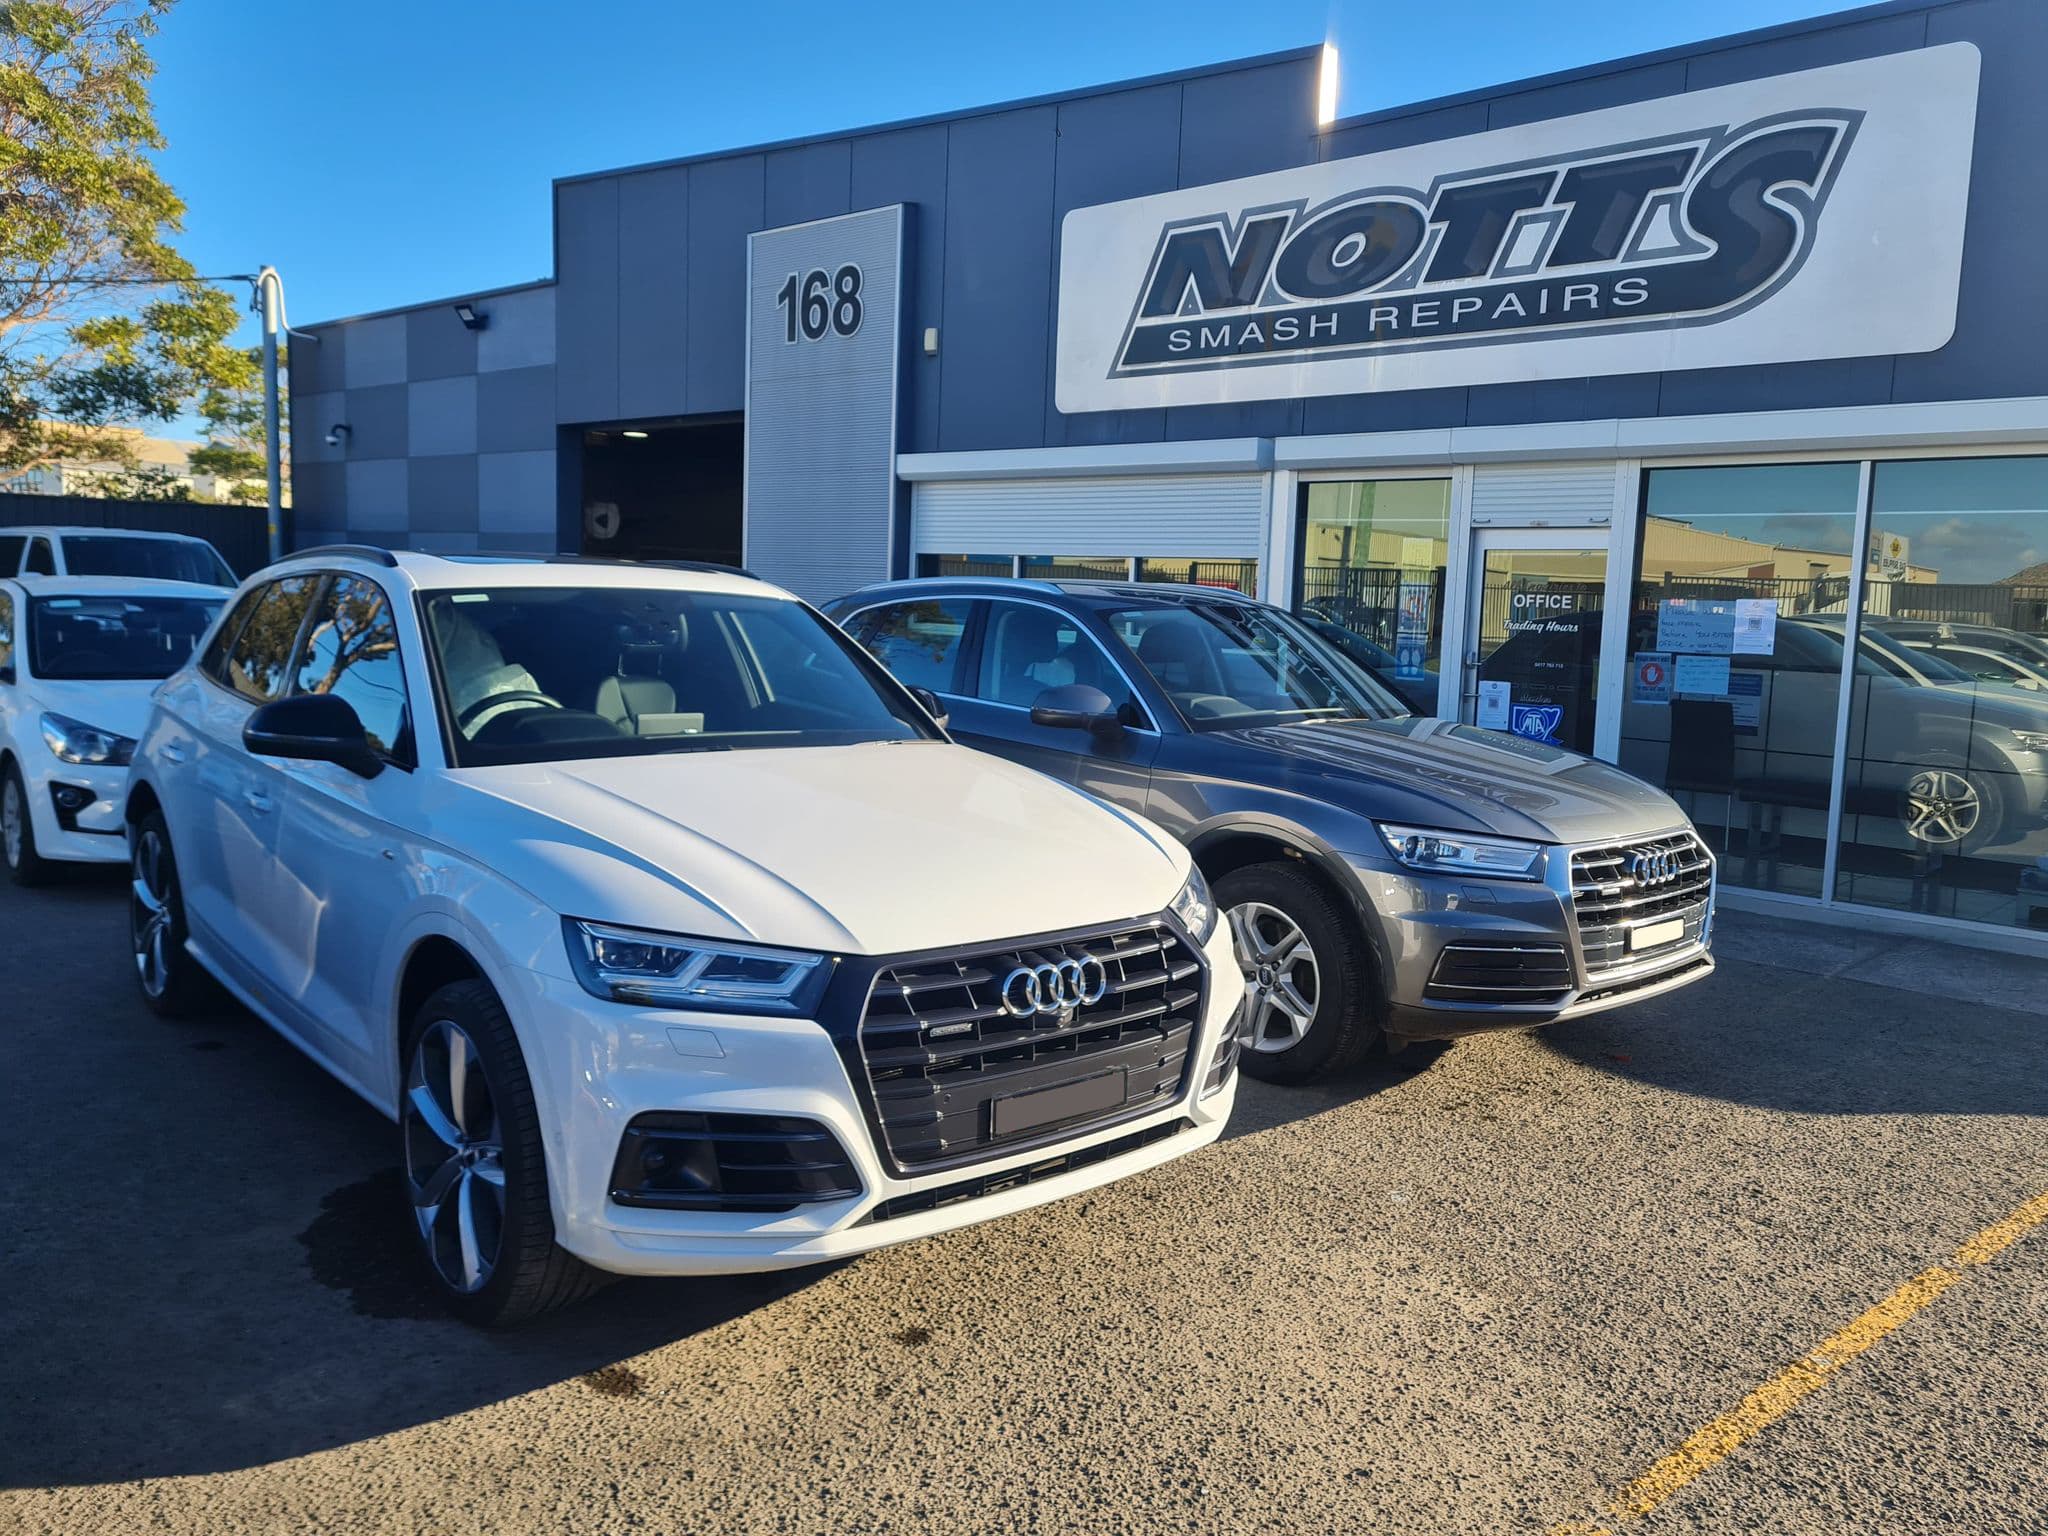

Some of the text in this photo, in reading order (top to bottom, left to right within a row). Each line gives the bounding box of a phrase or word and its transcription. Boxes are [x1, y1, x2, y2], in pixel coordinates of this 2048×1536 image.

[1137, 114, 1852, 320] NOTTS
[776, 262, 864, 344] 168
[1167, 276, 1652, 353] SMASH REPAIRS
[1513, 594, 1573, 609] OFFICE
[1503, 619, 1580, 634] Trading Hours
[1521, 714, 1546, 736] MTA
